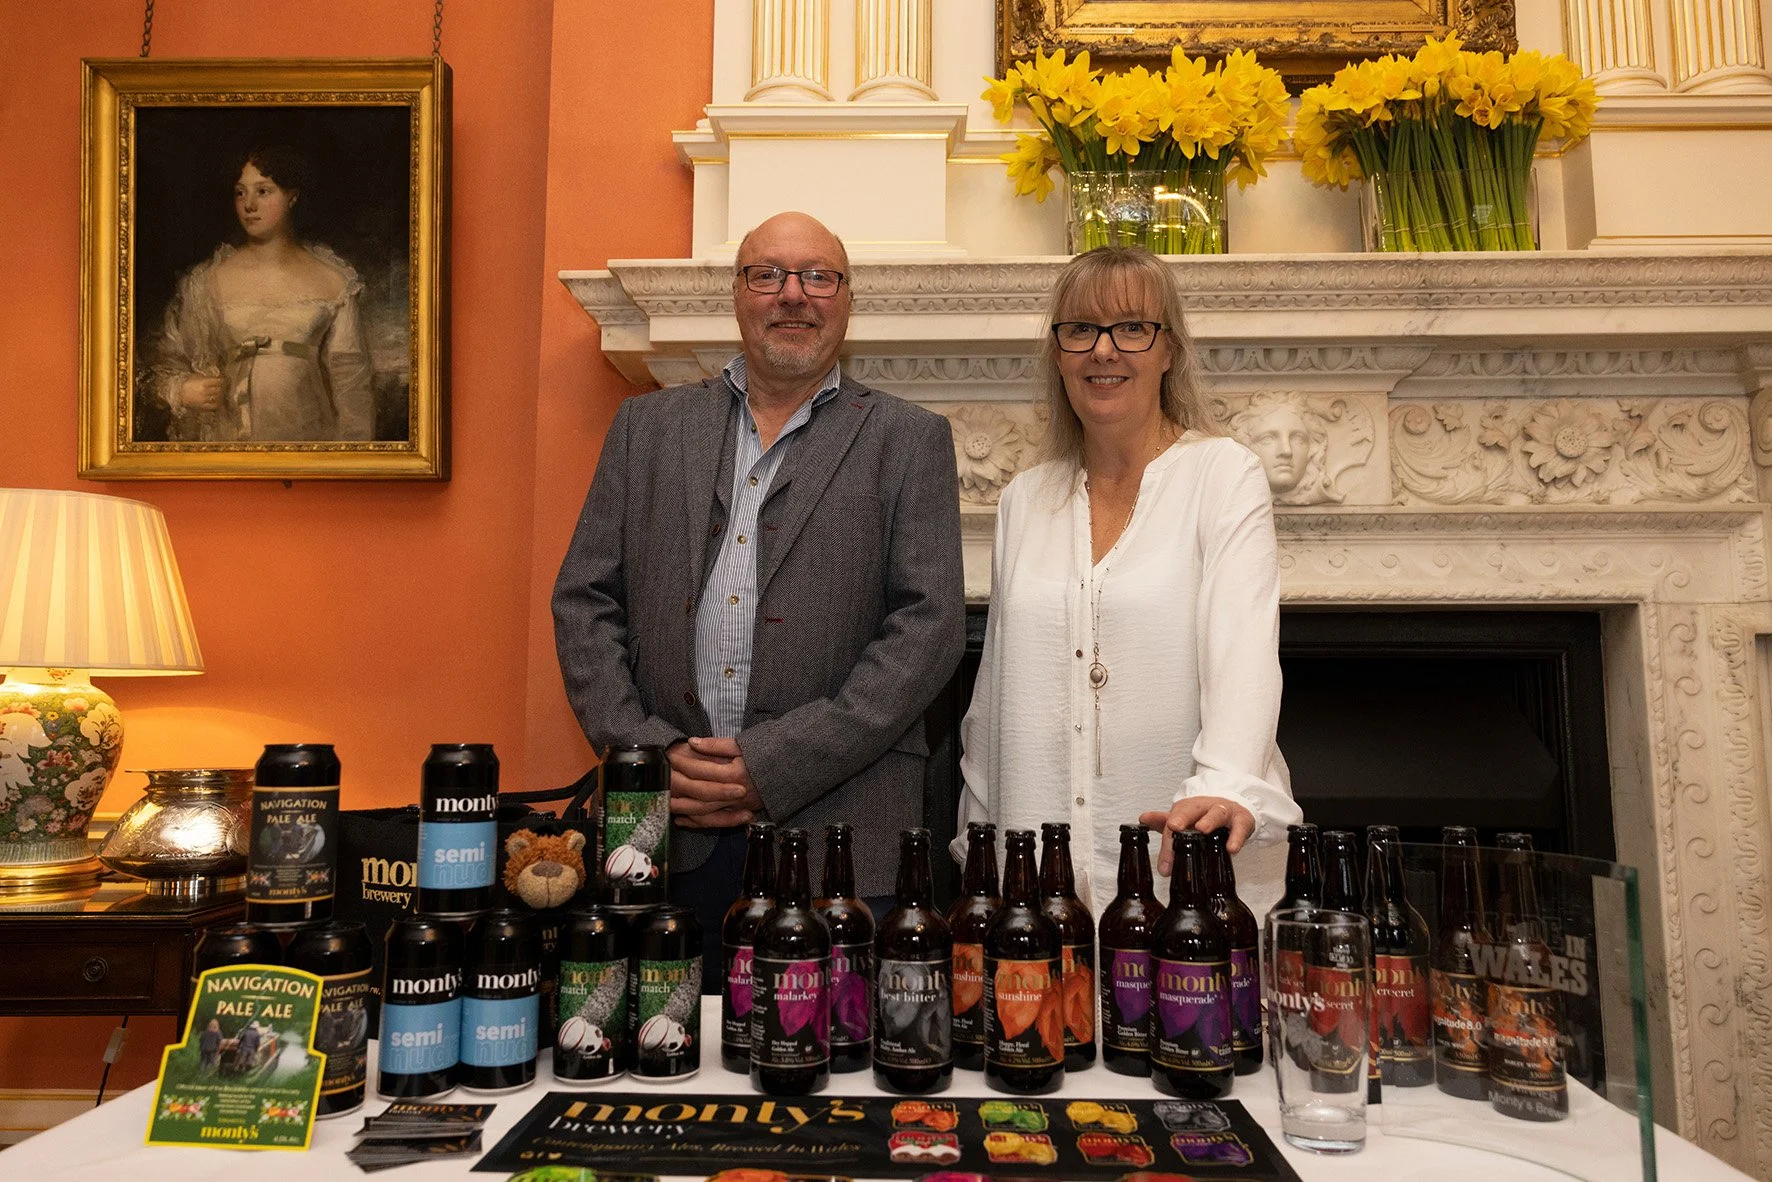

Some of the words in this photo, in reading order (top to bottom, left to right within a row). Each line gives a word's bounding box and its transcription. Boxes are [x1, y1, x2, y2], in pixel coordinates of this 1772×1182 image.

[260, 799, 328, 811] NAVIGATION
[266, 814, 291, 825] PALE
[296, 813, 317, 825] ALE
[607, 813, 637, 824] match
[434, 841, 485, 864] semi
[362, 882, 412, 909] brewery
[1565, 934, 1587, 961] IN
[1467, 943, 1588, 998] WALES
[207, 976, 314, 999] NAVIGATION
[560, 984, 588, 995] match
[641, 982, 671, 994] match
[1116, 980, 1151, 991] masque
[774, 990, 817, 1003] malarkey
[881, 988, 900, 1001] best
[904, 991, 937, 1003] bitter
[998, 990, 1042, 1002] sunshine
[216, 1000, 255, 1017] PALE
[260, 1003, 293, 1018] ALE
[1326, 1001, 1353, 1011] secret
[476, 1017, 526, 1041] semi
[1466, 1019, 1482, 1031] 8.0
[391, 1023, 443, 1047] semi
[563, 1100, 866, 1134] monty's
[200, 1125, 260, 1144] monty's
[548, 1115, 694, 1139] brewery
